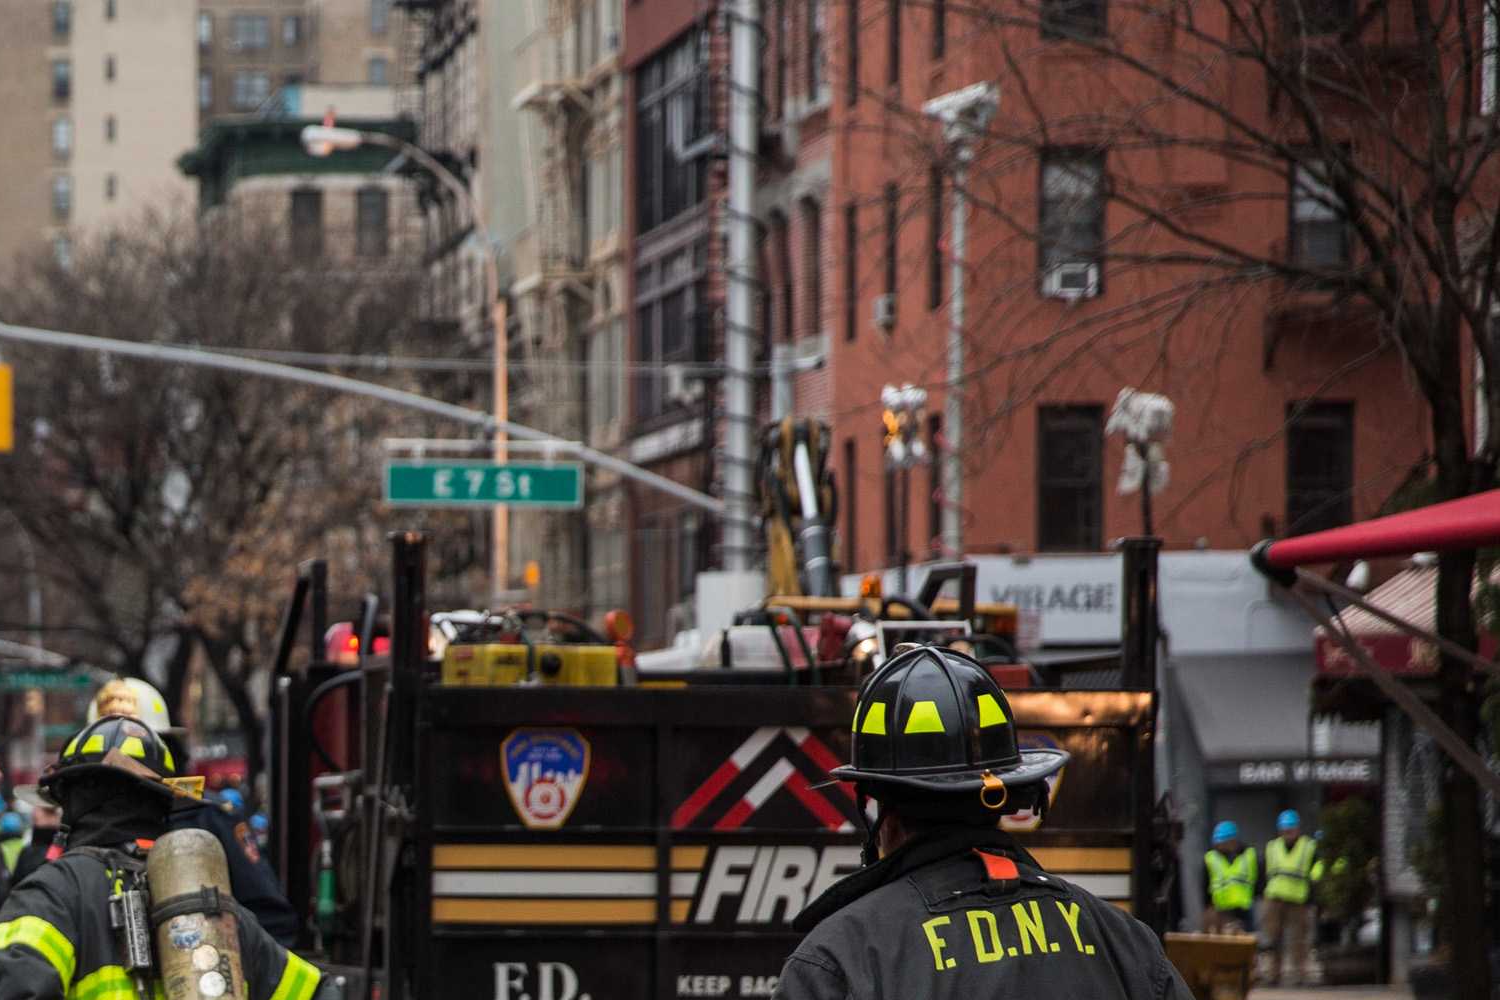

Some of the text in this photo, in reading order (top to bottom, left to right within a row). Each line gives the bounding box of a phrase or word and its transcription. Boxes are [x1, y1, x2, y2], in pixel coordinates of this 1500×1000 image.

[433, 469, 531, 498] E 7 St
[922, 900, 1095, 971] F.D.N.Y.
[677, 976, 731, 996] KEEP
